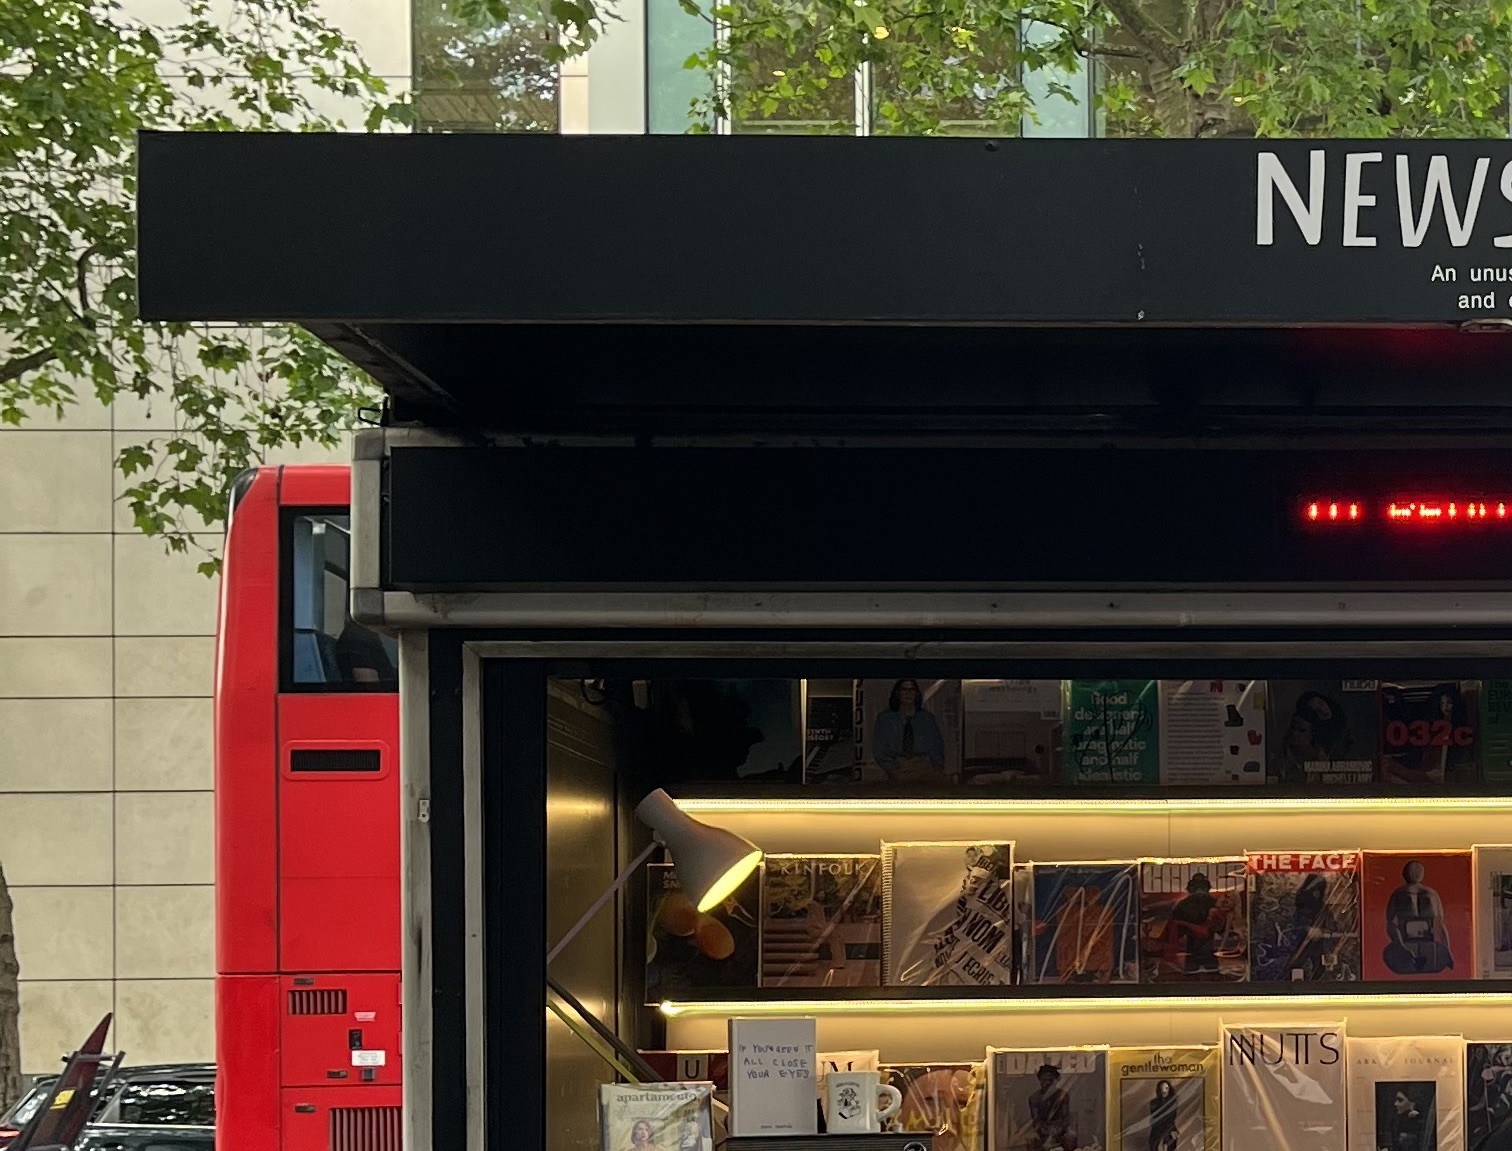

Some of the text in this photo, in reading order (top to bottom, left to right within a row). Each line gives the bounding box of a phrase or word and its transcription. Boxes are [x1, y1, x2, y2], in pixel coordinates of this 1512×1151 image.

[1431, 264, 1457, 282] An
[1457, 292, 1495, 310] and
[1386, 719, 1475, 747] 032c
[1251, 853, 1357, 870] THE FACE
[744, 1057, 809, 1068] ALL CLOSE
[1153, 1052, 1173, 1066] the
[1120, 1060, 1204, 1077] gentlewoman
